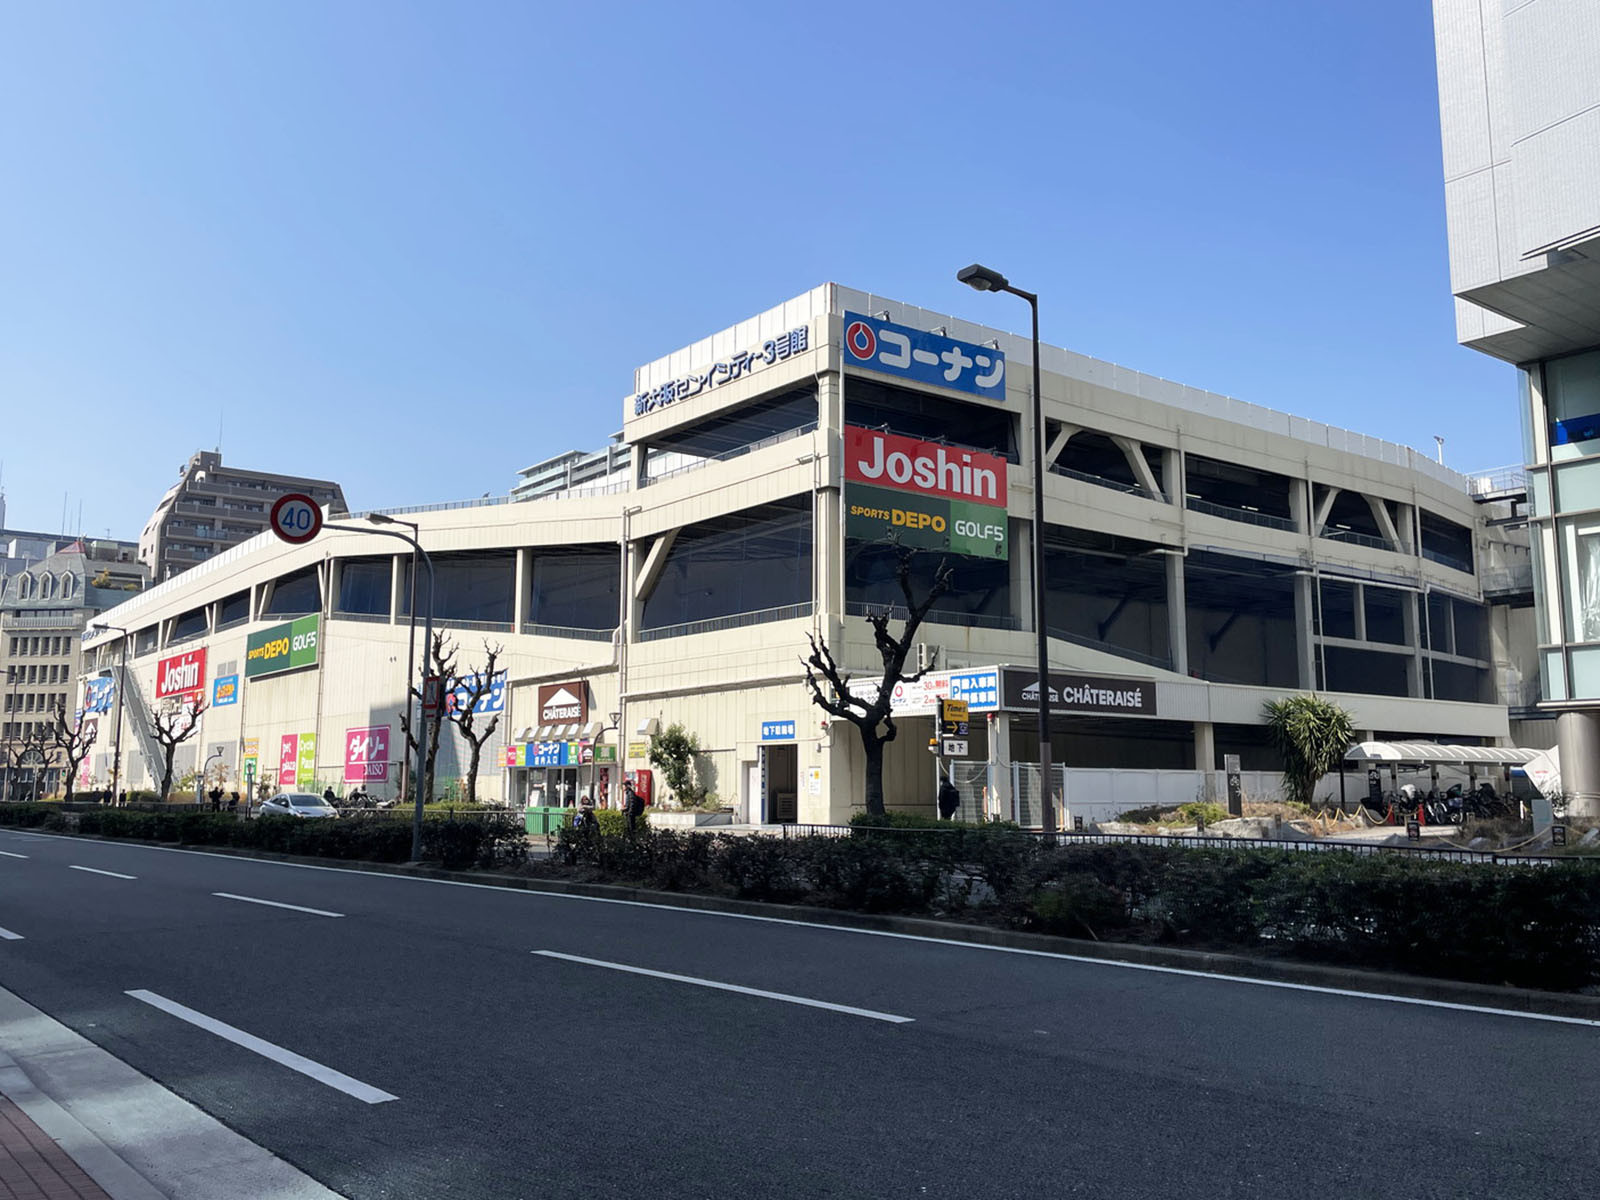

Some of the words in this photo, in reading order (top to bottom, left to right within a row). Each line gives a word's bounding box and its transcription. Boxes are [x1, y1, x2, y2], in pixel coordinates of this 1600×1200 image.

[878, 329, 1004, 388] コーナン
[857, 436, 997, 500] Joshin
[282, 507, 310, 530] 40
[850, 505, 890, 520] SPORTS
[891, 508, 946, 533] DEPO
[954, 520, 1004, 541] GOLF5
[264, 637, 289, 659] DEPO
[292, 631, 317, 651] GOLF5
[161, 654, 199, 695] Joshin
[1063, 684, 1142, 707] CHÂTERAISÉ
[350, 735, 385, 761] ダイソー
[538, 743, 560, 755] コーナン
[948, 743, 964, 753] 地下
